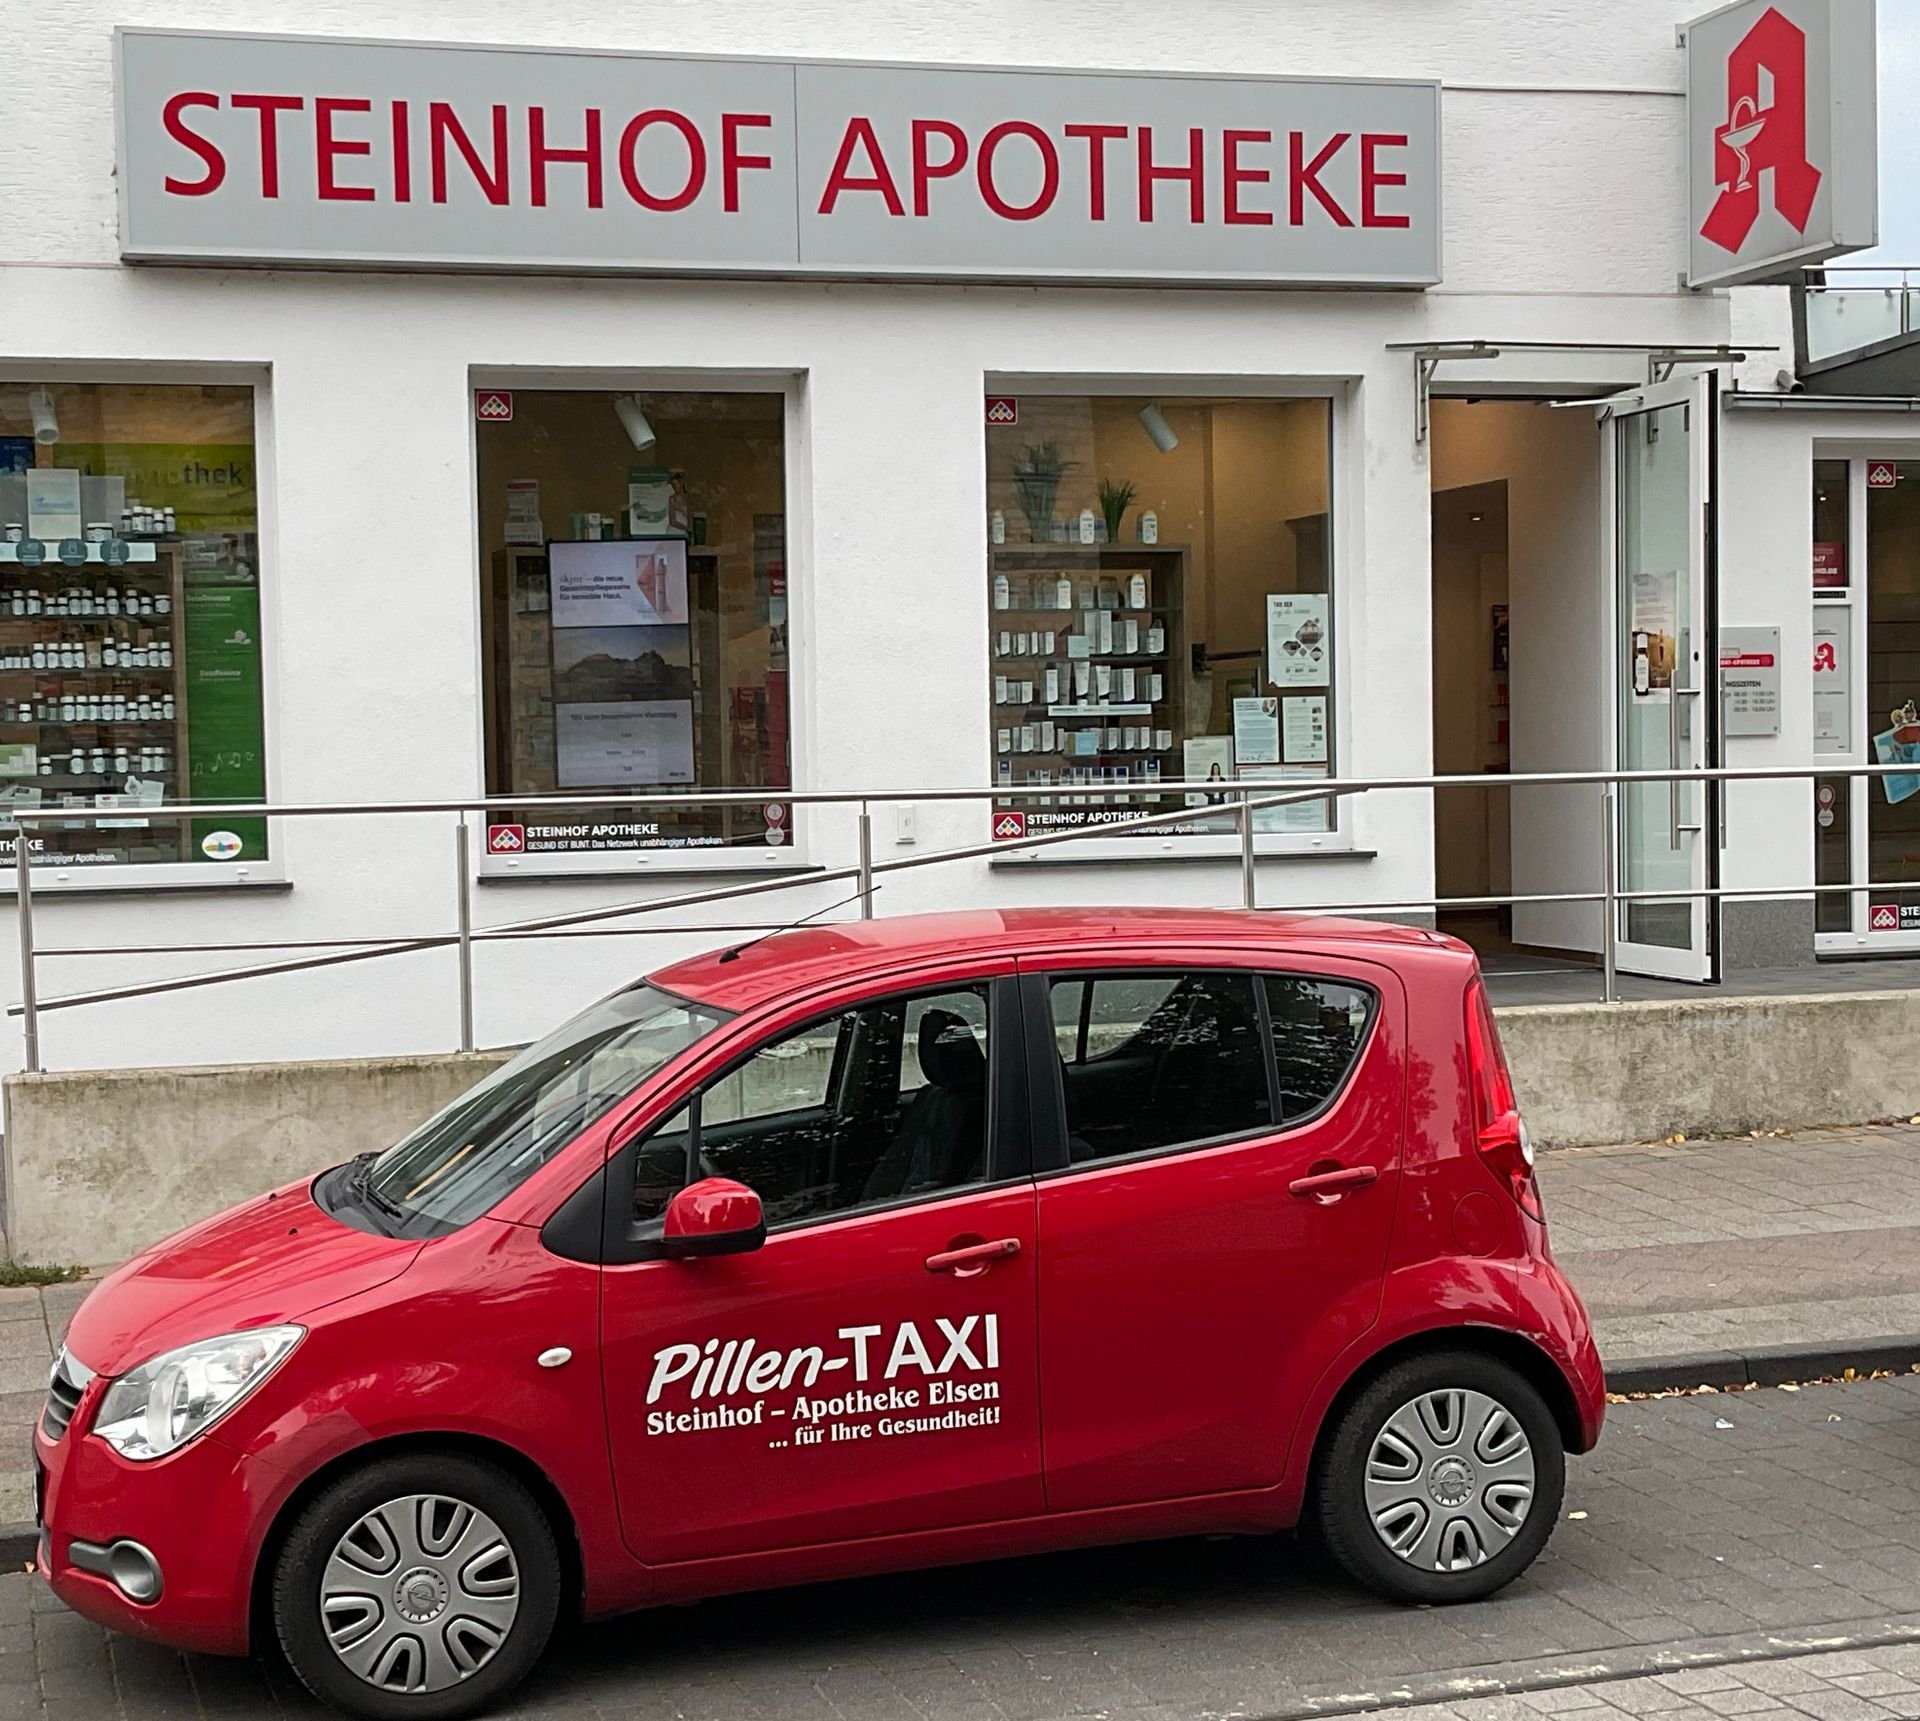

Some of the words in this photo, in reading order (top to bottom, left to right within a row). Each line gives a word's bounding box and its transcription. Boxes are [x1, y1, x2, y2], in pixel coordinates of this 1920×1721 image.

[162, 91, 772, 213] STEINHOF
[817, 117, 1411, 228] APOTHEKE
[526, 825, 590, 838] STEINHOF
[591, 823, 659, 836] APOTHEKE
[1027, 812, 1085, 825] STEINHOF
[1087, 811, 1150, 823] APOTHEKE
[0, 839, 44, 851] THKE
[646, 1314, 1000, 1404] Pillen-TAXI
[647, 1401, 764, 1436] Steinhof
[792, 1385, 920, 1424] Apotheke
[928, 1379, 1000, 1406] Elsen
[795, 1426, 823, 1446] für
[831, 1418, 872, 1441] Ihre
[878, 1406, 1000, 1437] Gesundheit!
